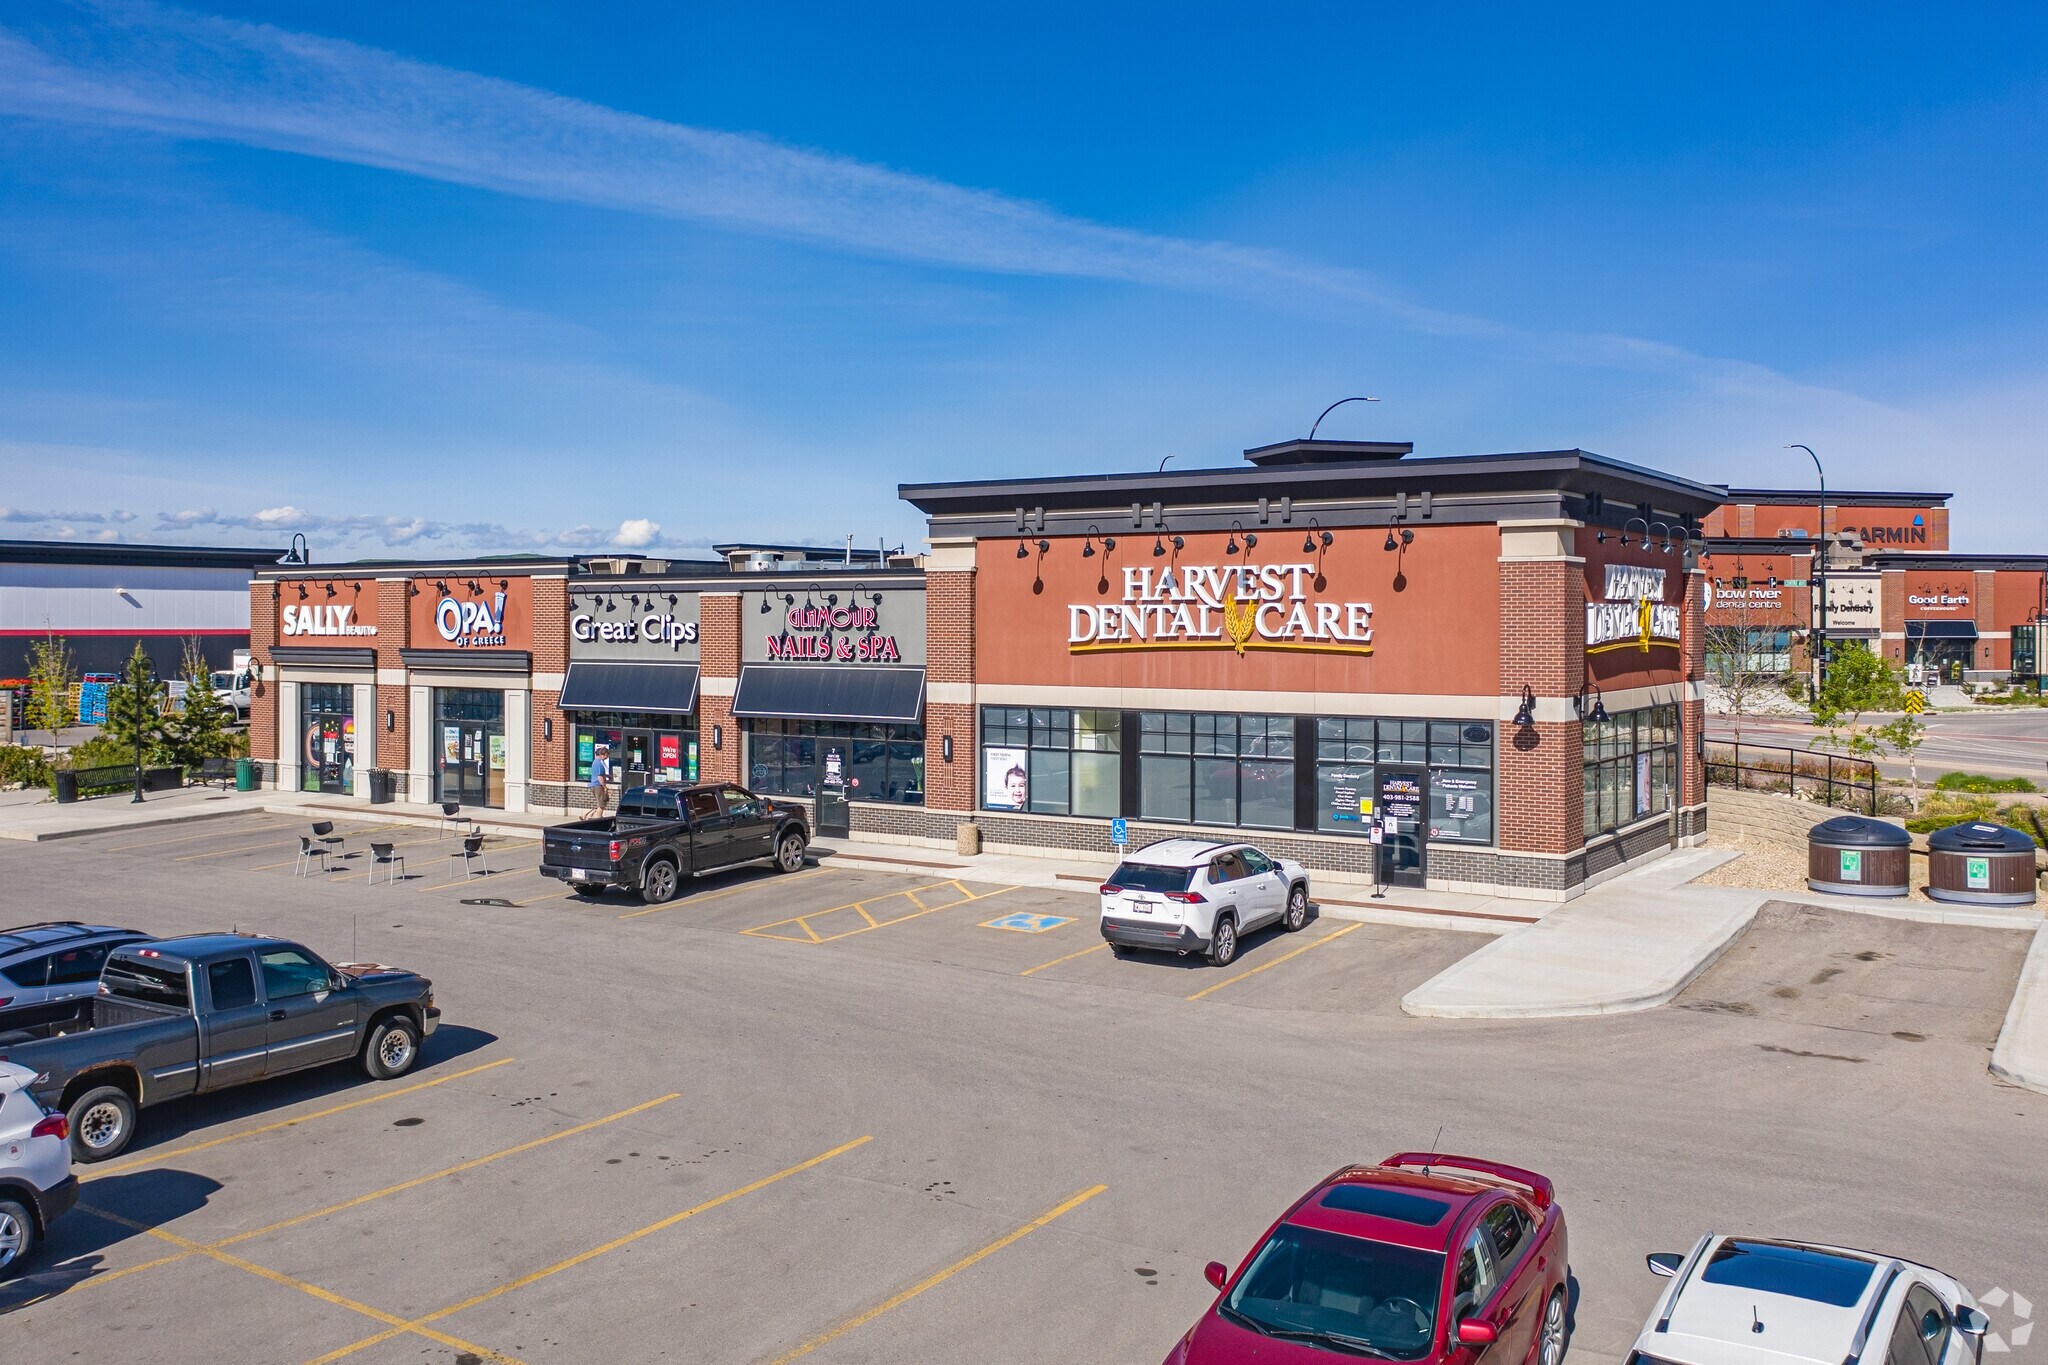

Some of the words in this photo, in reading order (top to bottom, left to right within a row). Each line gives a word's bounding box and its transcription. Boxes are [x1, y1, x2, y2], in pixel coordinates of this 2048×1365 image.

[1122, 564, 1316, 608] HARVEST
[1716, 588, 1747, 599] bow
[1749, 587, 1782, 599] river
[1749, 600, 1782, 609] centre
[1840, 604, 1874, 615] Dentistry
[1908, 595, 1938, 604] Good
[1940, 595, 1970, 604] Earth
[283, 605, 352, 635] SALLY
[346, 625, 371, 636] BEAUTY
[437, 592, 507, 641] OPA!
[788, 606, 876, 628] GLAMOUR
[1068, 602, 1223, 643] DENTAL
[1254, 601, 1375, 642] CARE
[456, 637, 468, 646] OF
[472, 635, 505, 646] GREECE
[571, 614, 636, 640] Great
[641, 614, 697, 648] Clips
[765, 635, 830, 658] NAILS
[835, 636, 853, 659] &
[857, 636, 898, 659] SPA
